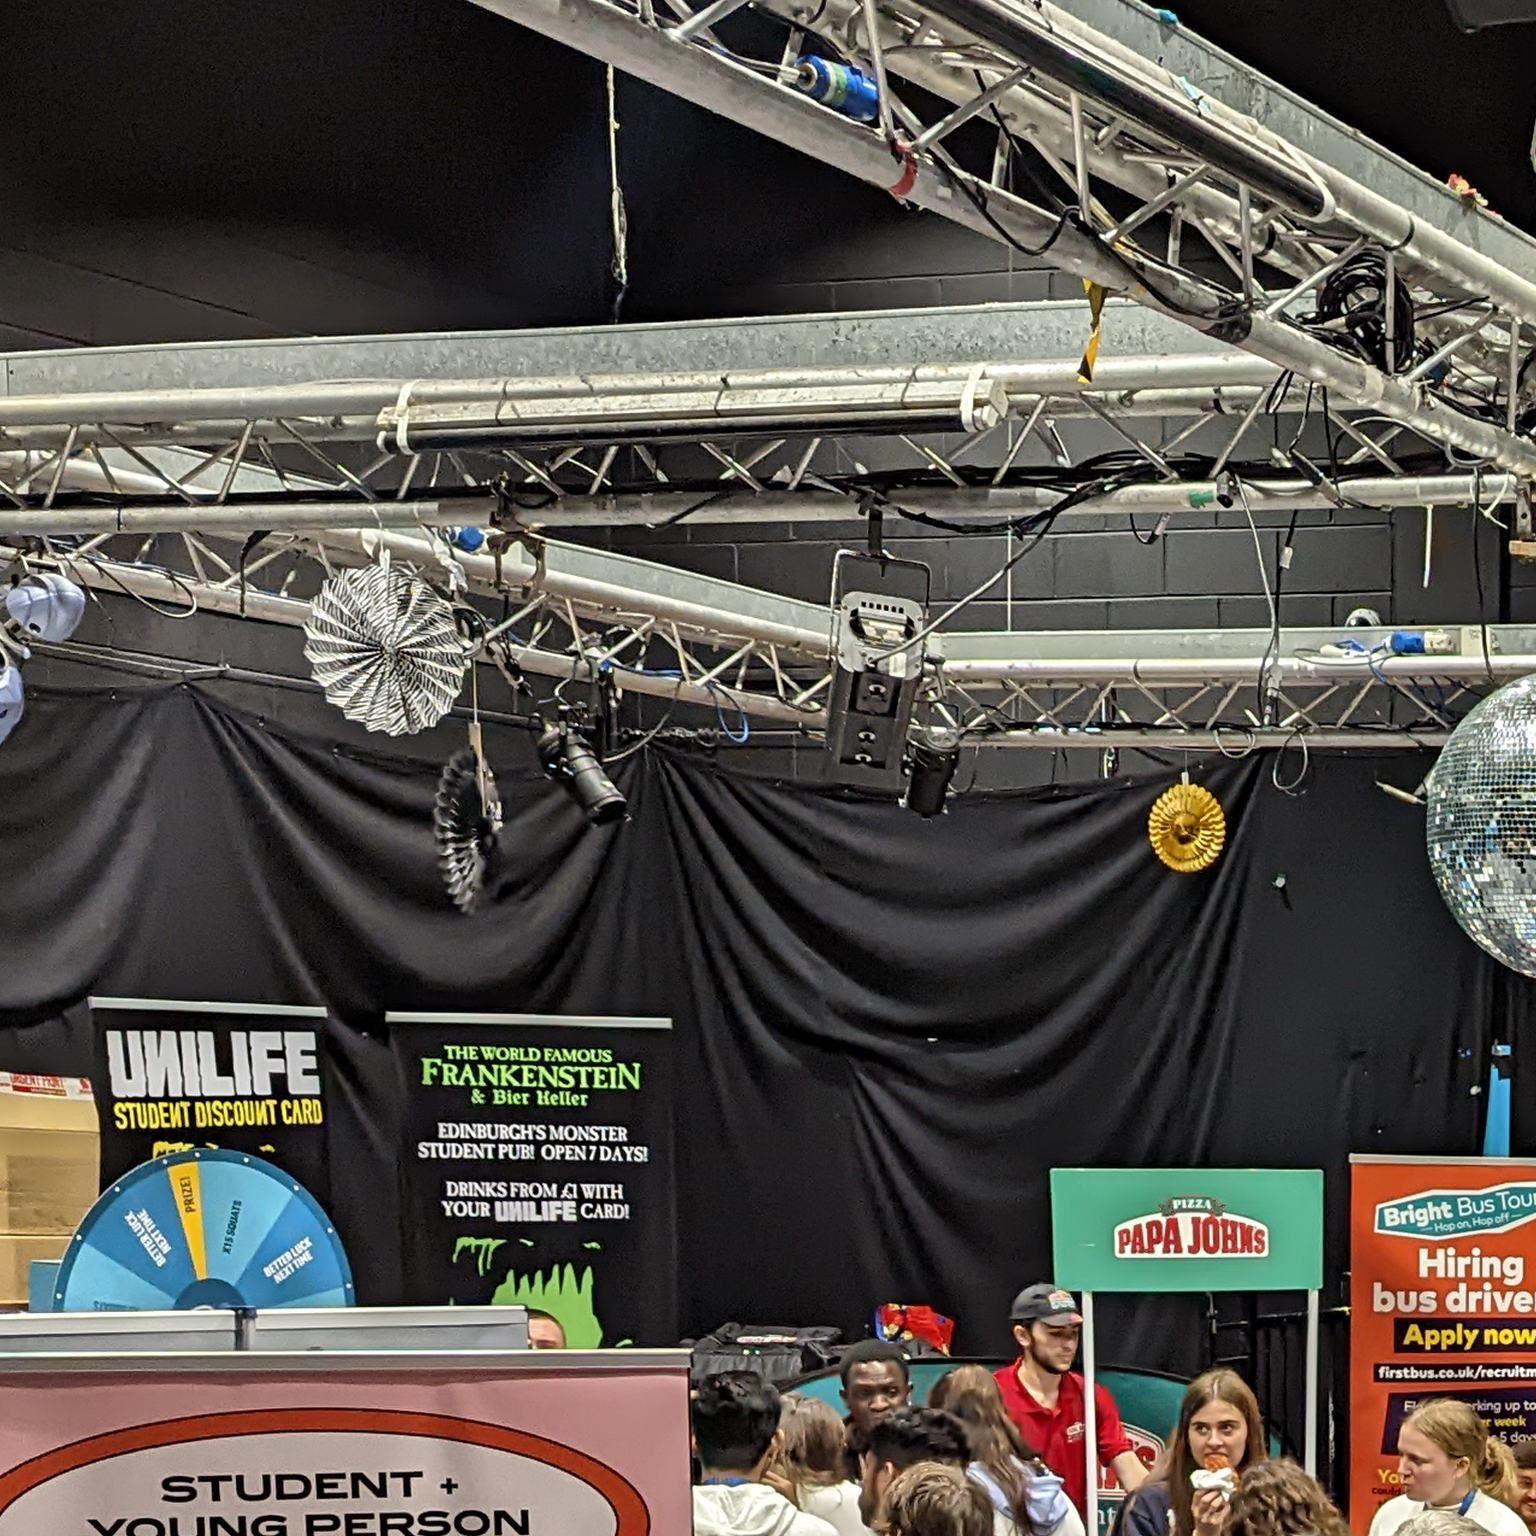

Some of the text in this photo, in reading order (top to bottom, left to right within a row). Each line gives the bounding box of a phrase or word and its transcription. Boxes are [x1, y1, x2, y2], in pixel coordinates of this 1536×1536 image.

[106, 1030, 320, 1097] UNILIFE
[444, 1045, 612, 1063] THE WORLD FAMOUS
[421, 1058, 640, 1090] FRANKENSTEIN
[471, 1089, 485, 1104] &
[493, 1090, 530, 1105] Bier
[114, 1099, 323, 1129] STUDENT DISCOUNT CARD
[438, 1123, 627, 1142] EDINBURGH'S MONSTER
[418, 1142, 647, 1162] STUDENT PUB! OPEN 7 DAYS!
[179, 1175, 193, 1213] PRIZE!
[446, 1181, 507, 1198] DRINKS
[510, 1182, 557, 1198] FROM
[580, 1184, 623, 1200] WITH
[1173, 1199, 1212, 1209] PIZZA
[226, 1200, 242, 1236] SQUATS
[442, 1201, 629, 1222] YOUR UNILIFE CARD!
[1383, 1201, 1452, 1227] Bright
[1457, 1197, 1495, 1217] Bus
[1434, 1222, 1455, 1232] Hop
[1472, 1217, 1493, 1227] Hop
[1495, 1213, 1510, 1223] off
[1118, 1216, 1265, 1254] PAPA JOHNS
[263, 1237, 313, 1278] BETTER LUCK
[273, 1250, 314, 1284] NEXT TIME
[1419, 1247, 1523, 1286] Hiring
[1373, 1282, 1437, 1313] bus
[1403, 1323, 1479, 1350] Apply
[160, 1471, 460, 1504] STUDENT +
